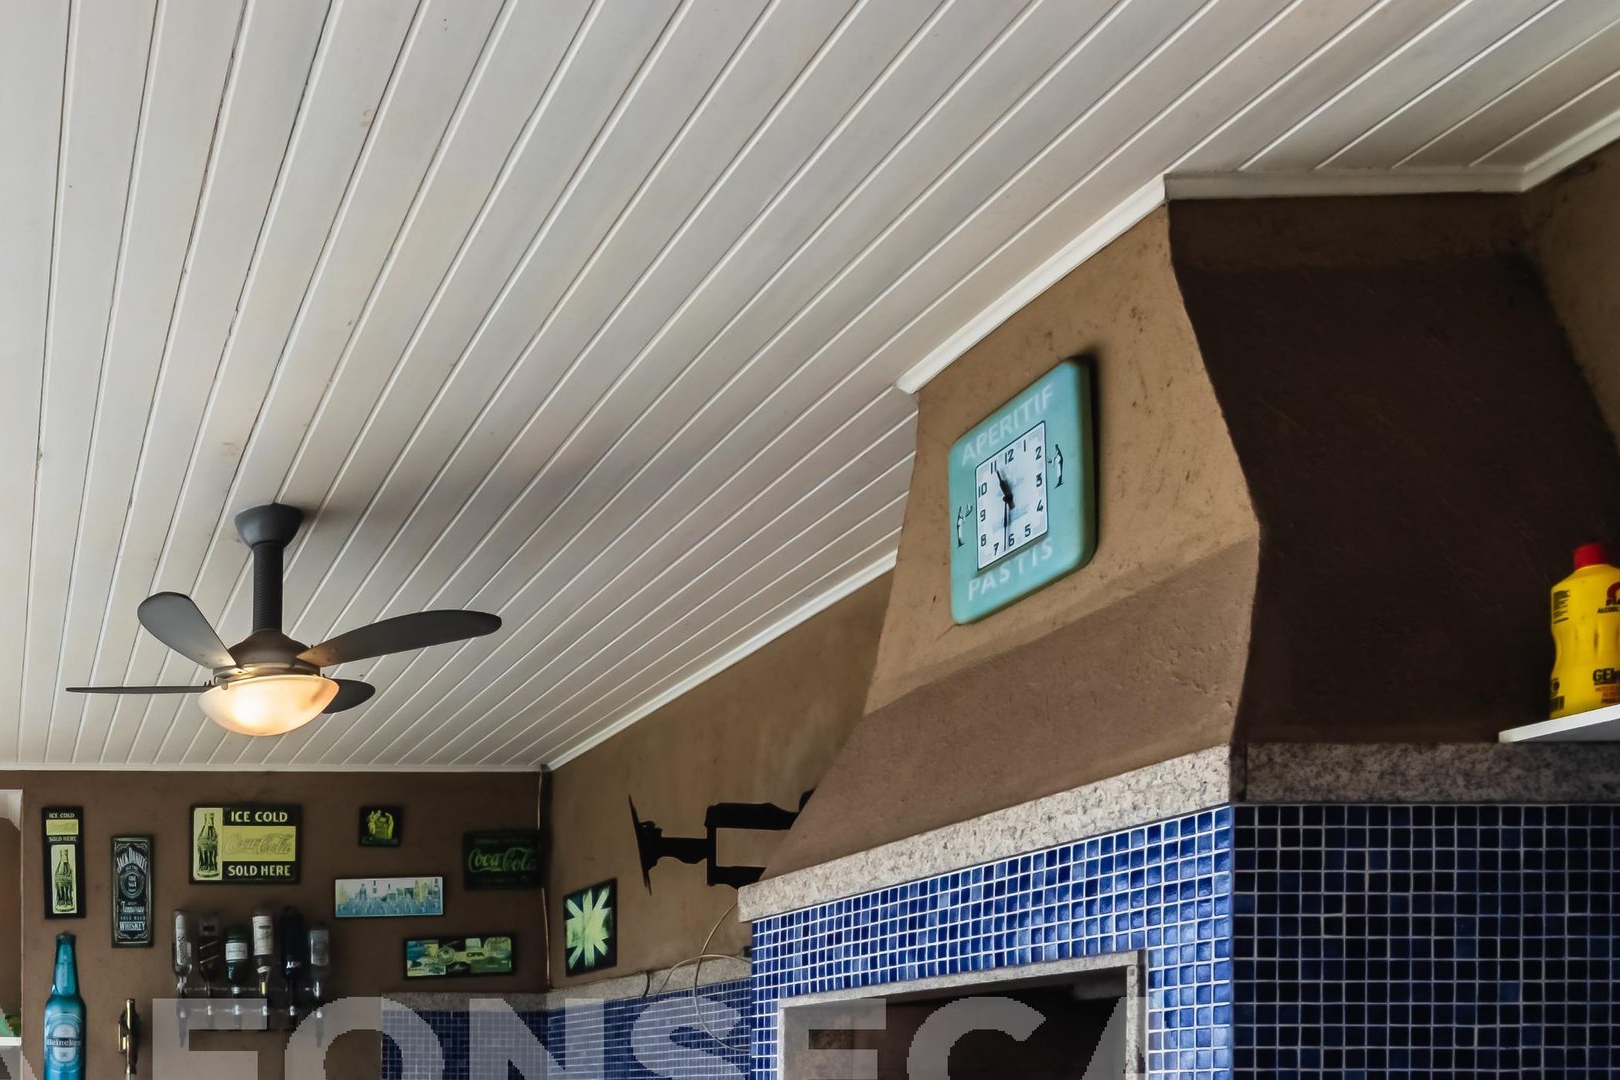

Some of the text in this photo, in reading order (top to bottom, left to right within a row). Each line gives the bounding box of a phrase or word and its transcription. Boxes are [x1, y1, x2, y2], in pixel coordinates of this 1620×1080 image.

[962, 382, 1053, 467] APERITIF
[1004, 448, 1015, 465] 12
[1035, 445, 1042, 461] 2
[1035, 472, 1043, 488] 3
[978, 482, 988, 498] 10
[1036, 499, 1044, 513] 4
[979, 508, 987, 522] 9
[1024, 523, 1032, 538] 5
[980, 533, 987, 547] 8
[1008, 533, 1015, 547] 6
[993, 542, 1000, 556] 7
[968, 538, 1053, 602] PASTIS
[231, 811, 288, 822] ICE COLD
[227, 865, 291, 877] SOLD HERE
